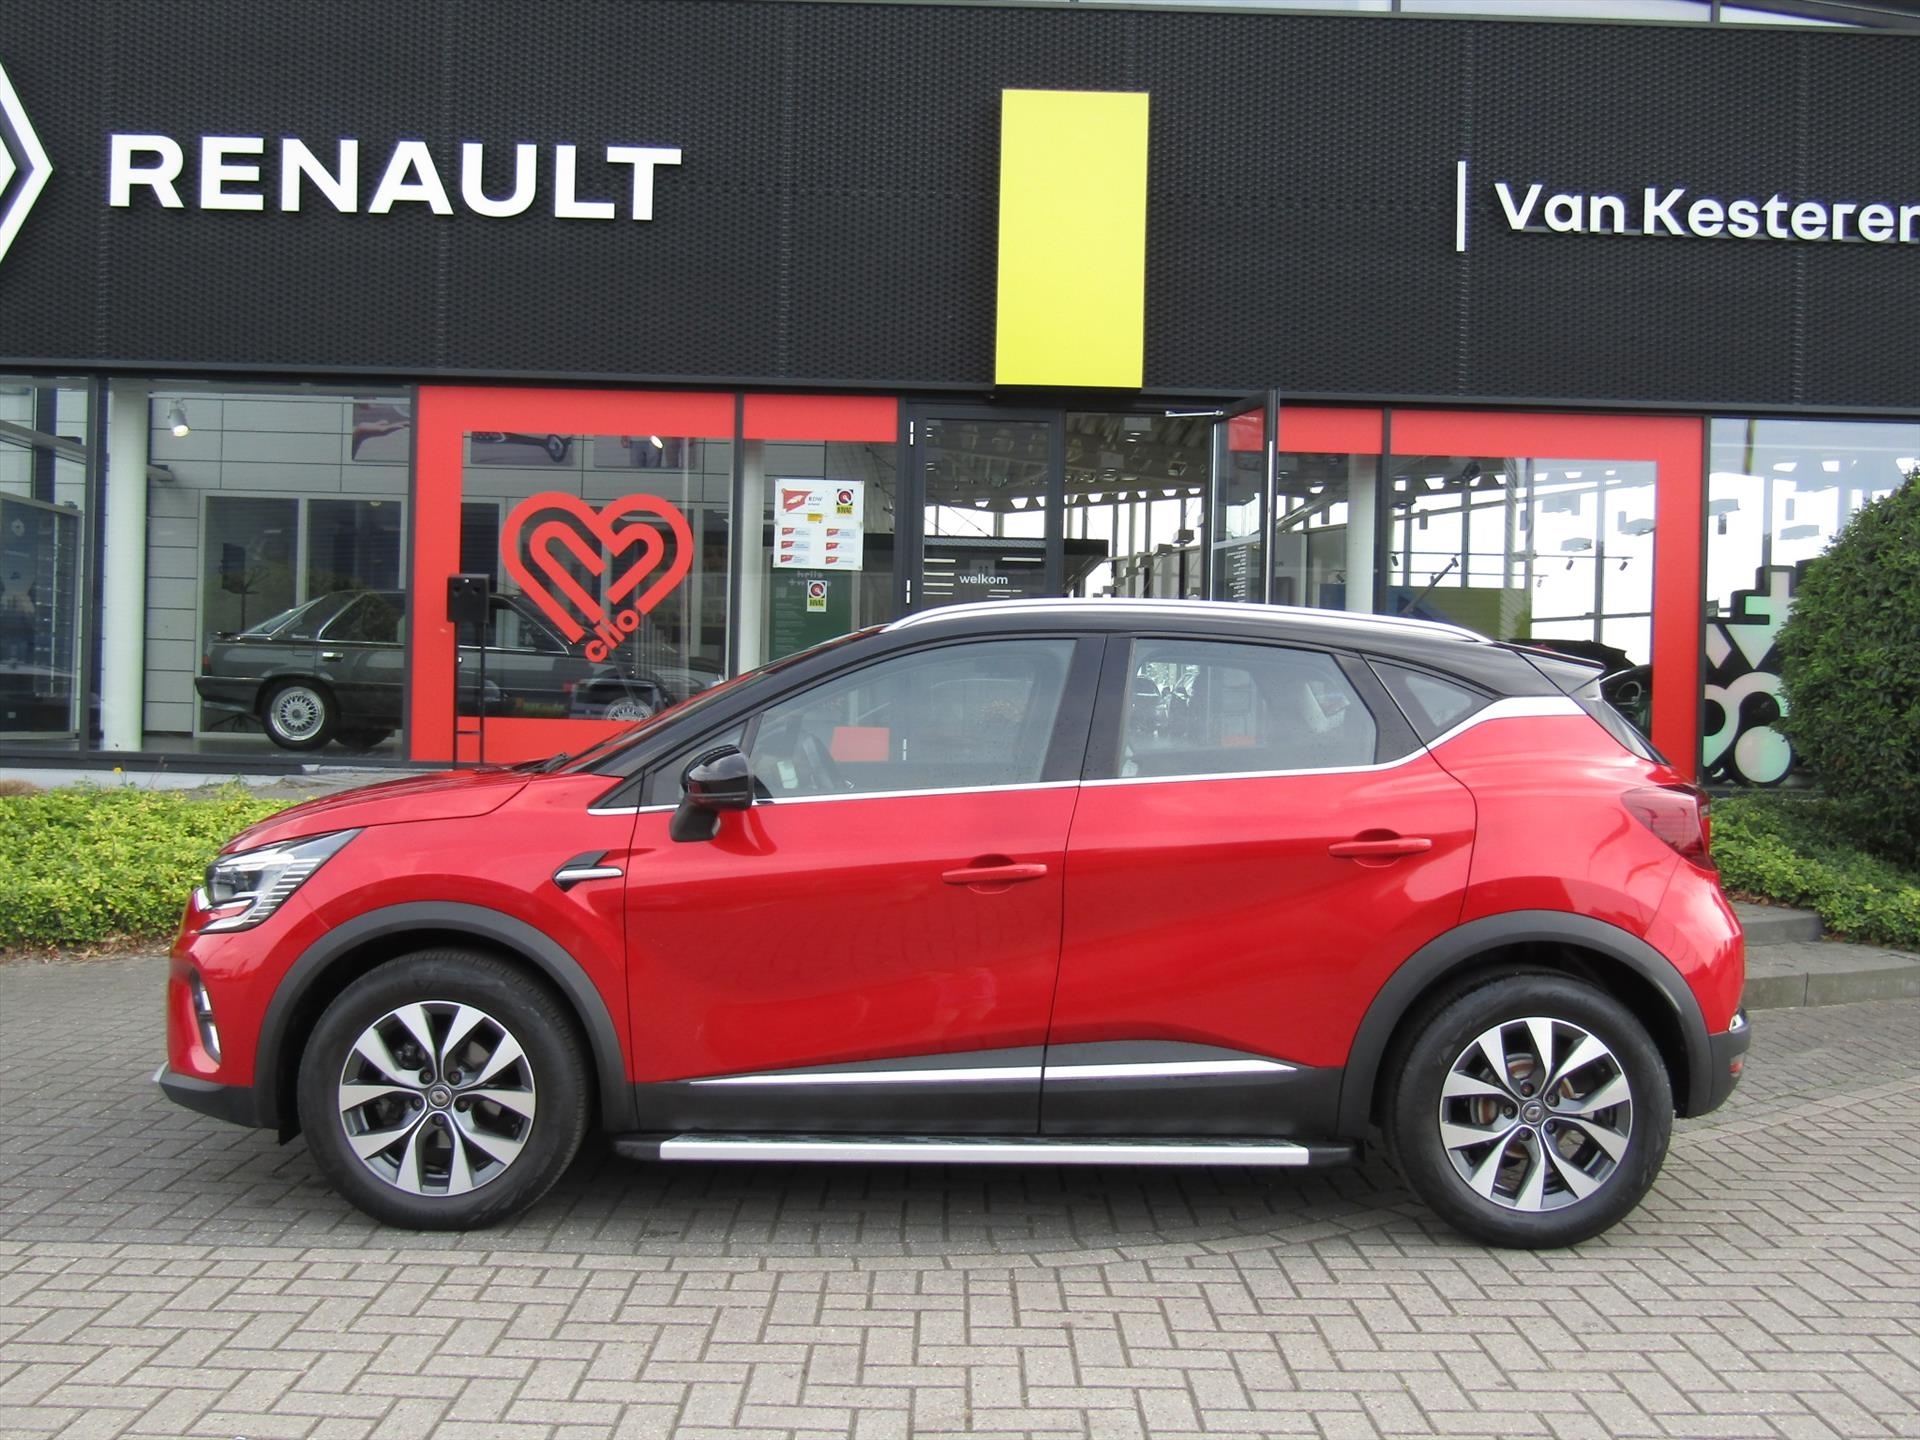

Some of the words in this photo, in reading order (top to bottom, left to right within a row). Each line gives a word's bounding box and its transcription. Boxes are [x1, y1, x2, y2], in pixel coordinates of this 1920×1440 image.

[109, 134, 682, 221] RENAULT
[1494, 183, 1625, 233] Van
[959, 573, 1009, 585] welkom
[585, 609, 640, 662] clio
